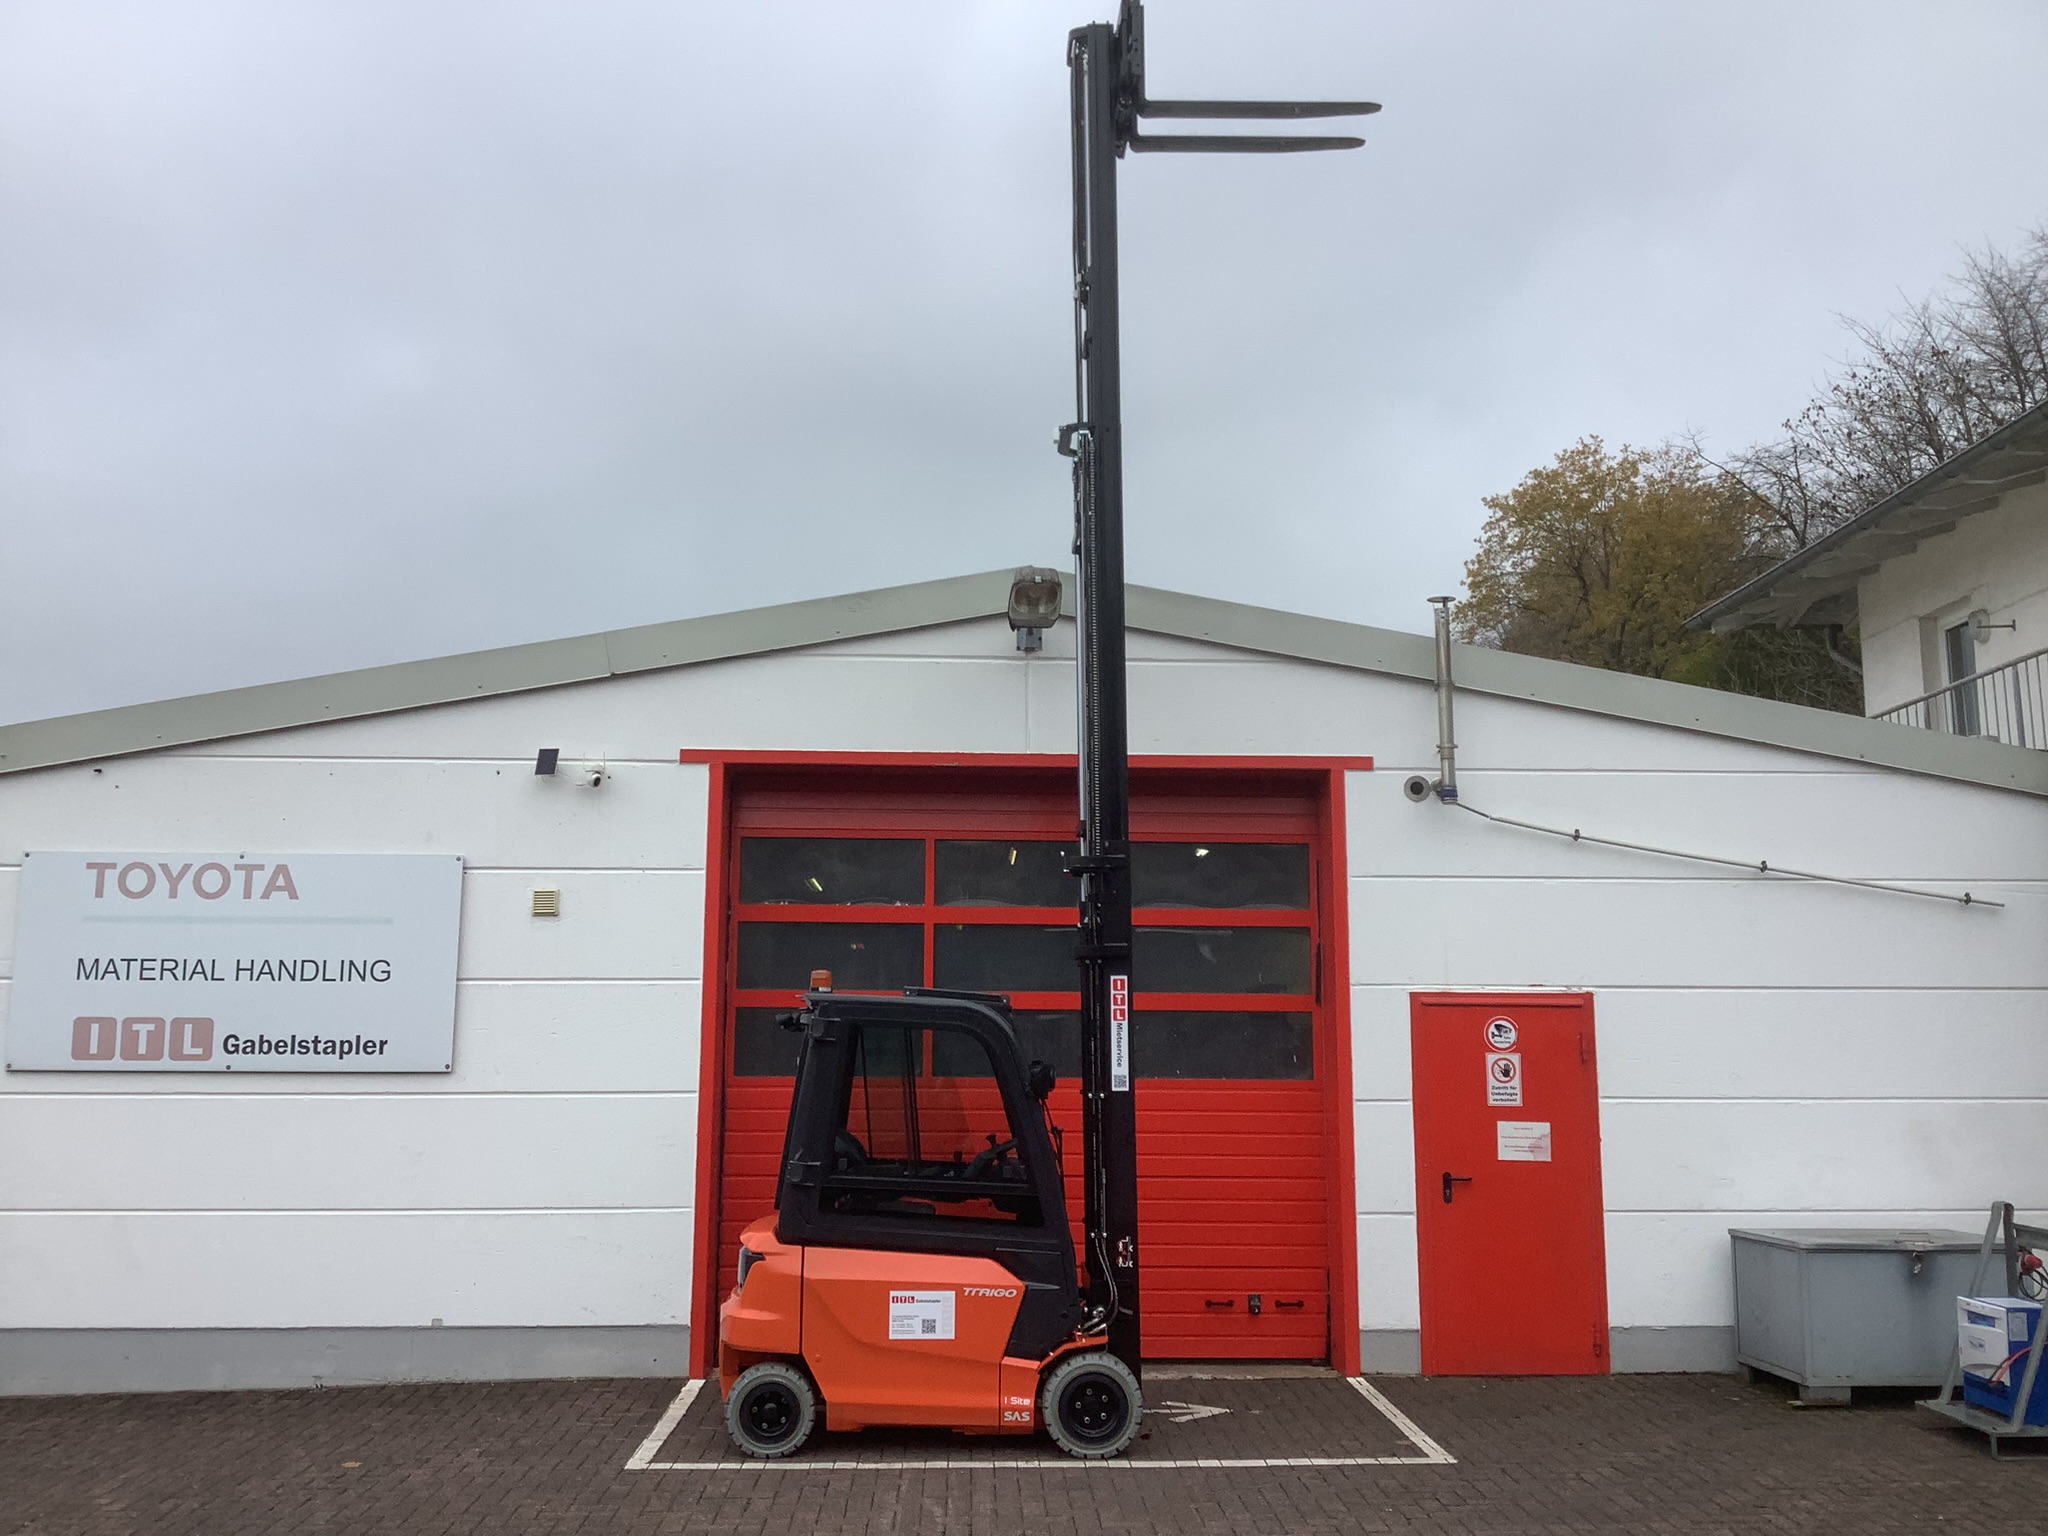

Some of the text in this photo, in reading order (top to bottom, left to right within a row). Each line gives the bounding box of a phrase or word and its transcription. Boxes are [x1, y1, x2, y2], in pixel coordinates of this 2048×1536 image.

[86, 861, 300, 900] TOYOTA
[76, 958, 392, 982] MATERIAL HANDLING
[86, 1021, 388, 1060] ITL Gabelstapler
[1114, 979, 1125, 1068] ITL Mietservice
[1004, 1411, 1030, 1421] SAS
